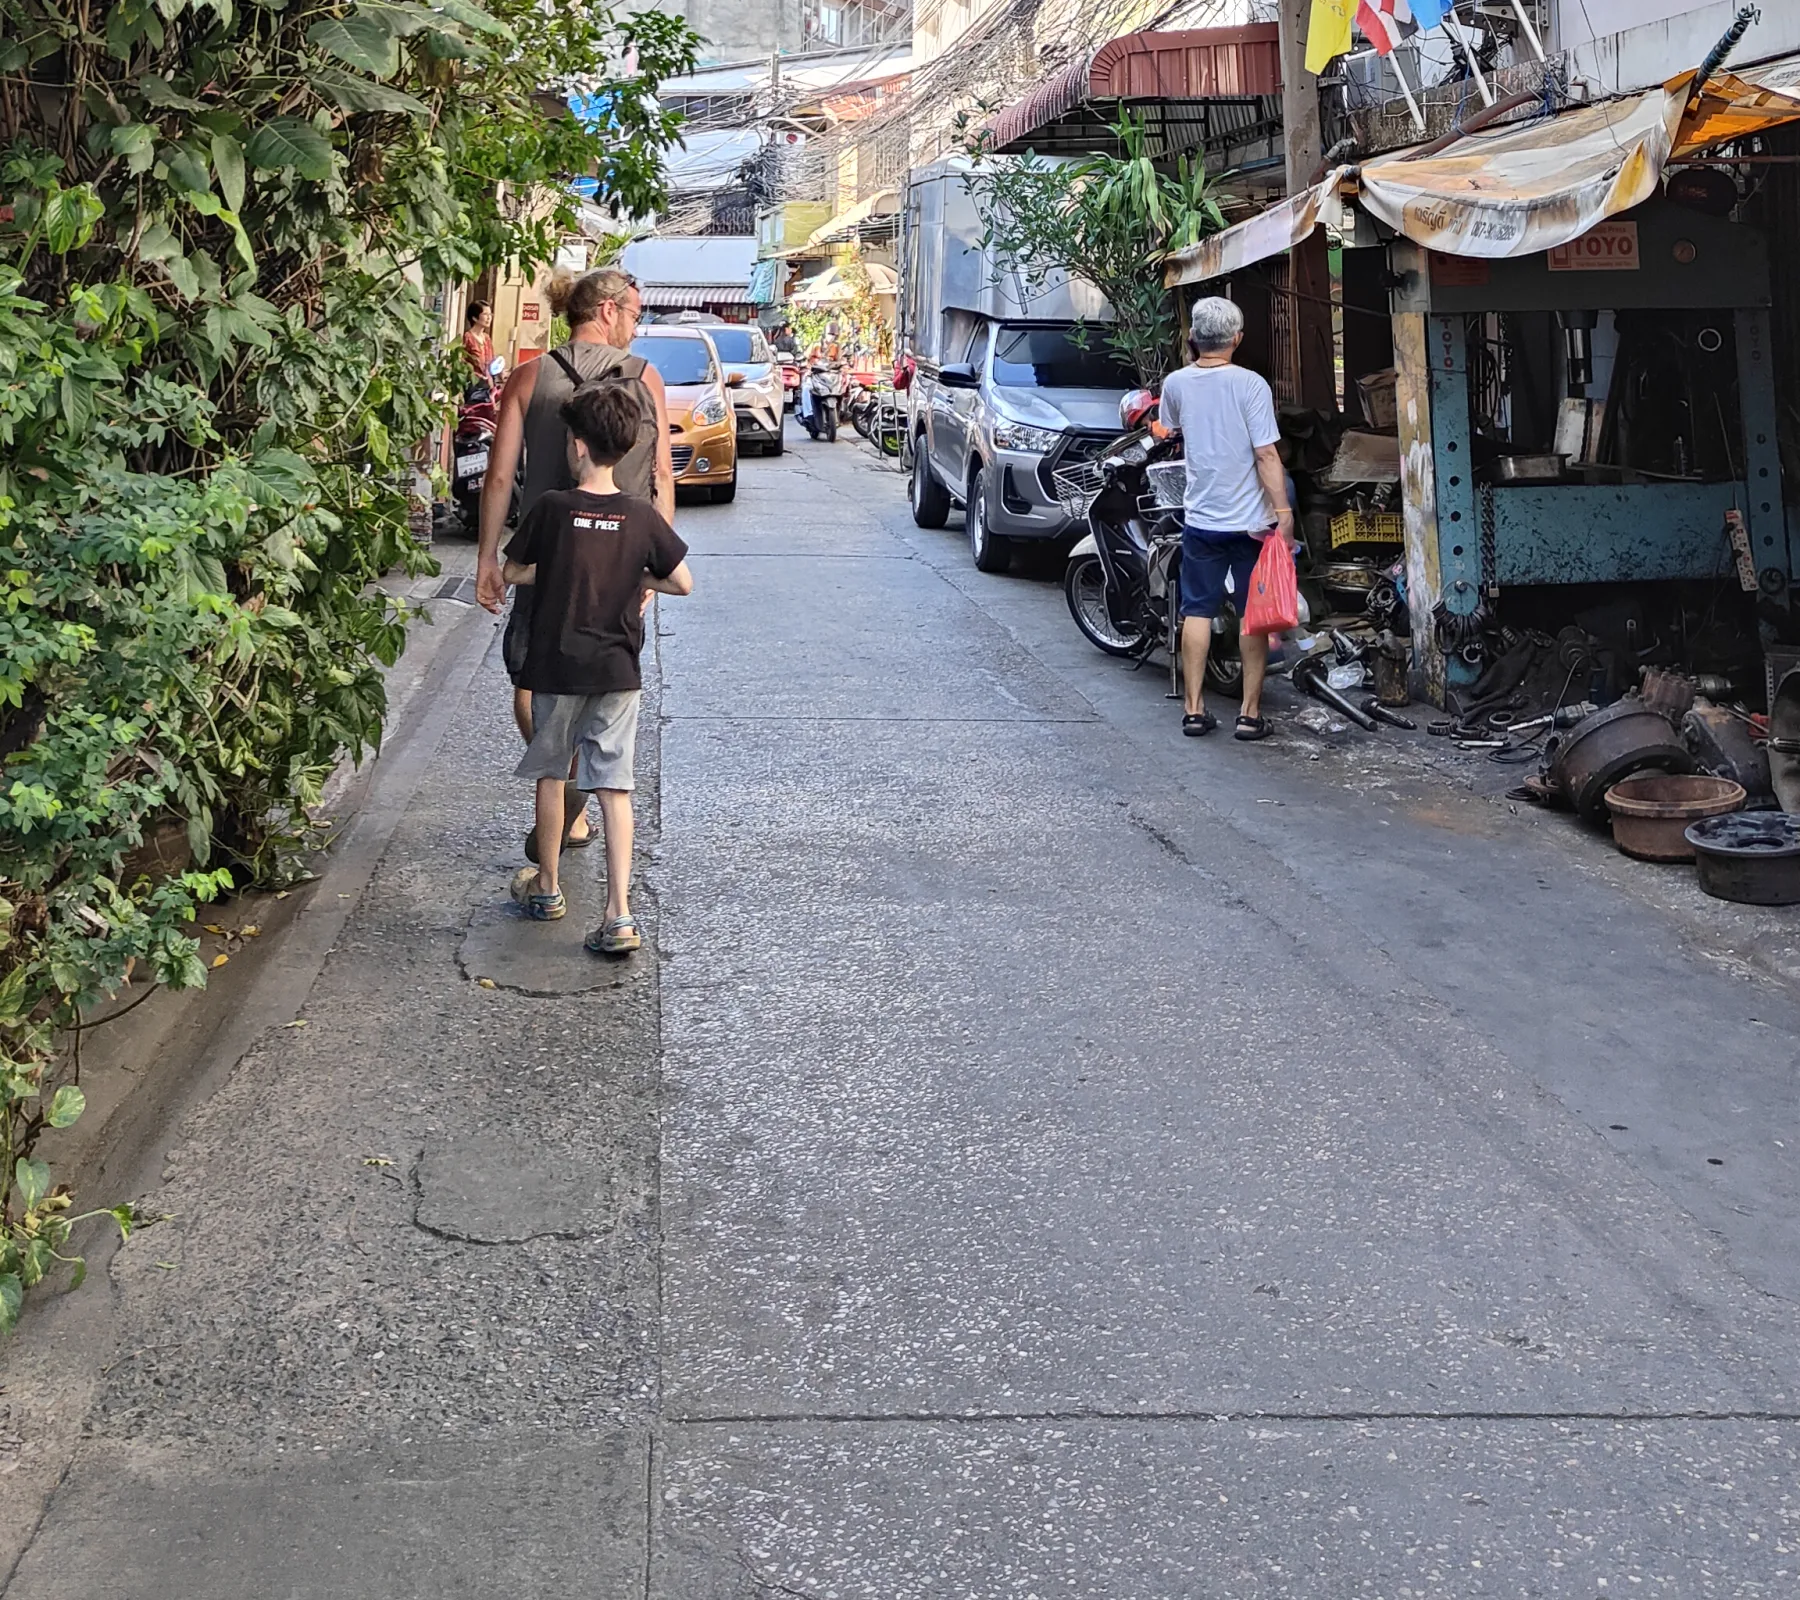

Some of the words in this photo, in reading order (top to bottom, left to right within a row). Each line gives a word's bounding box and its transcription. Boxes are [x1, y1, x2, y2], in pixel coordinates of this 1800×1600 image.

[1575, 236, 1633, 256] TOYO
[1441, 318, 1454, 369] TOYO
[573, 517, 593, 529] ONE
[595, 520, 620, 531] PIECE
